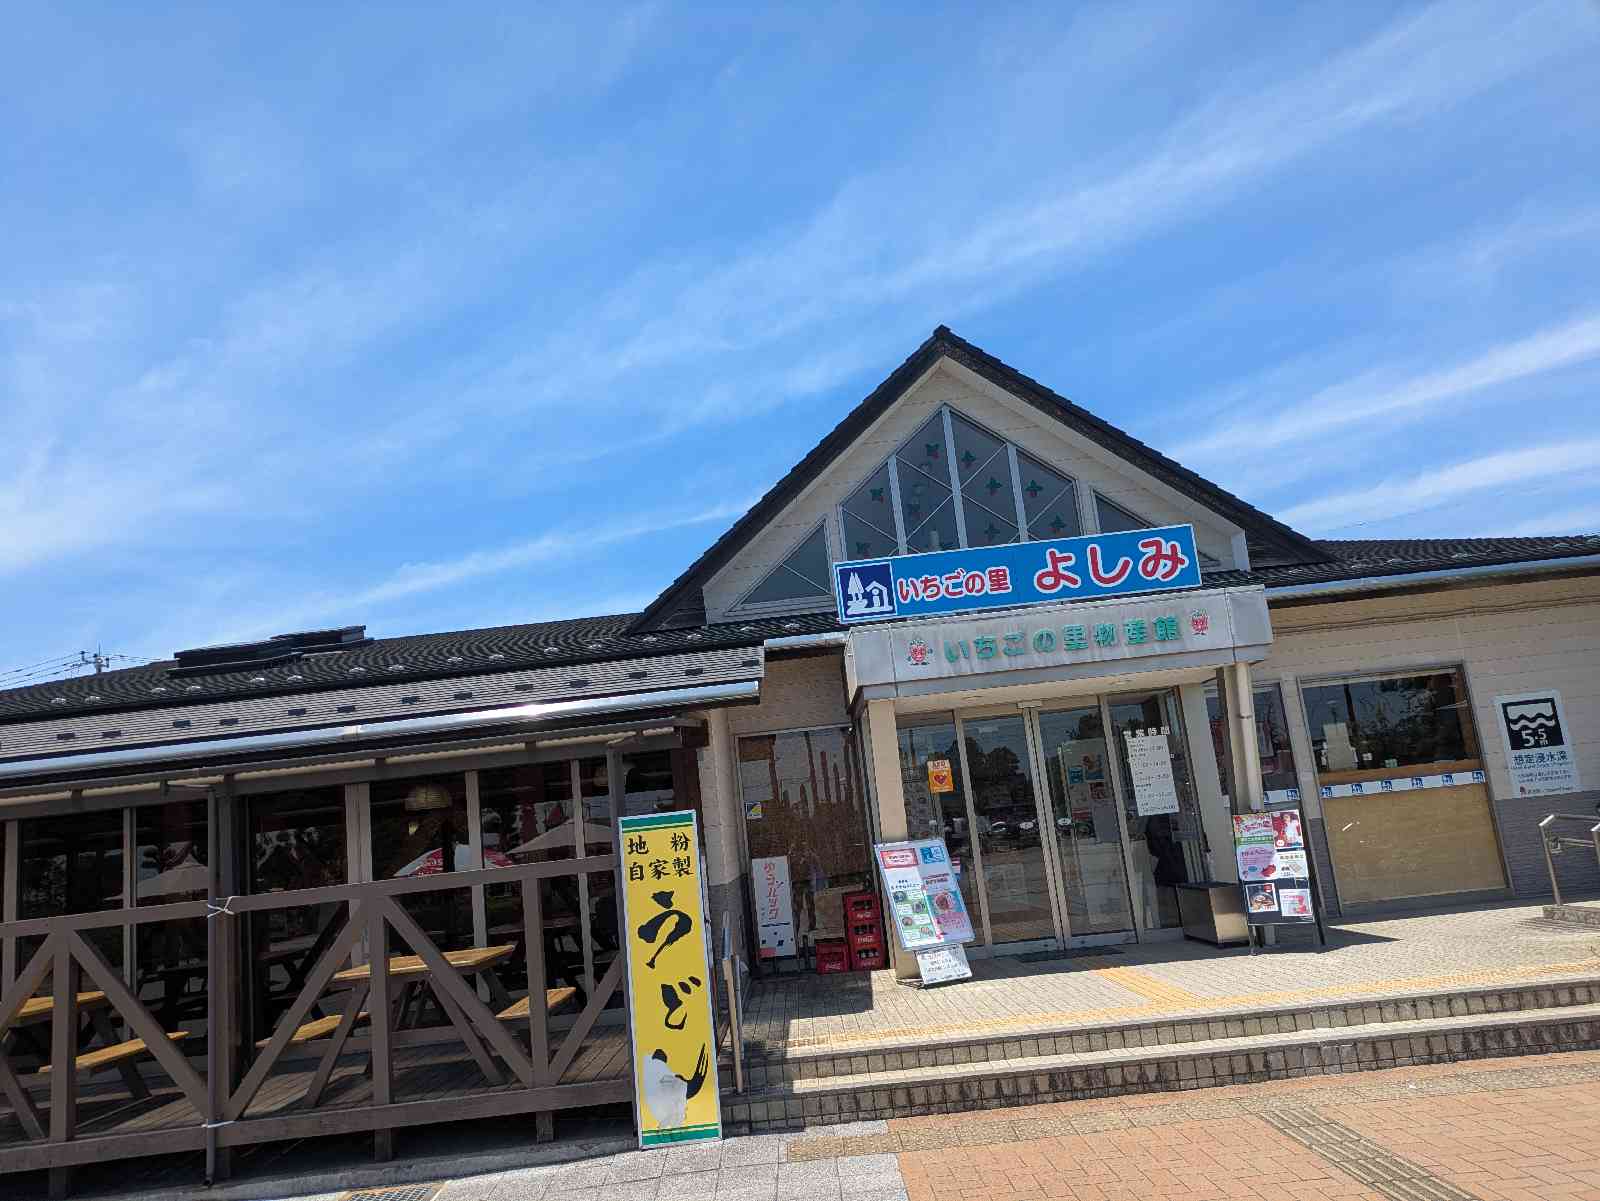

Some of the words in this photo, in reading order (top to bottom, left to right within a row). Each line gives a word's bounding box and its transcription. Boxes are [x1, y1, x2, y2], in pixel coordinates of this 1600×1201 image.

[897, 567, 1011, 603] いちごの里
[1034, 536, 1189, 594] よしみ
[943, 616, 1181, 660] いちごの里物産館
[629, 855, 694, 882] 自家製
